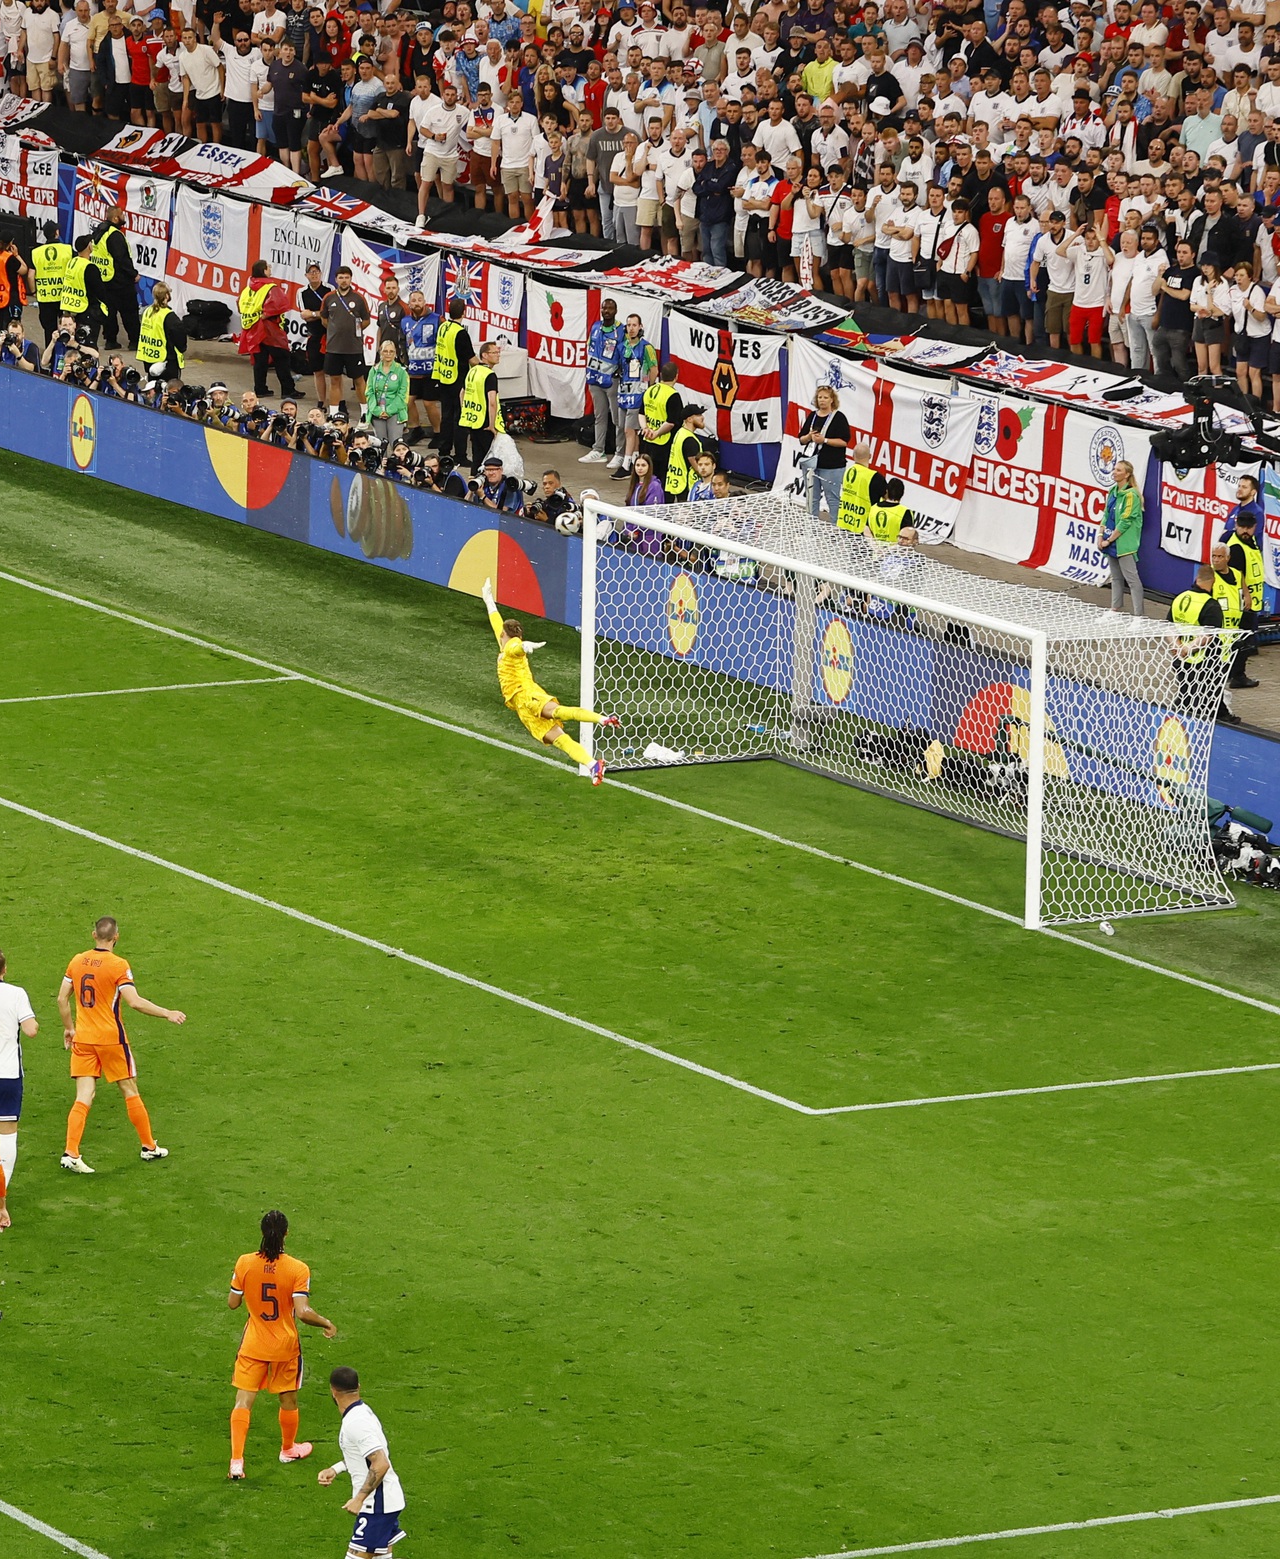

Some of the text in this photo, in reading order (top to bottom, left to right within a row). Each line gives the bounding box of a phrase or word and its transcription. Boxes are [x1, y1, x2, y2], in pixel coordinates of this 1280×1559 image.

[197, 144, 246, 168] ESSEX
[11, 183, 32, 201] ARE
[34, 188, 54, 205] QPR
[274, 228, 321, 253] ENGLAND
[136, 244, 157, 268] BB2
[271, 248, 292, 266] TILL
[1083, 273, 1091, 284] 8
[690, 327, 761, 359] WOLVES
[742, 412, 768, 432] WE
[929, 458, 960, 495] FC
[1166, 522, 1192, 544] DT7
[81, 974, 95, 1008] 6
[260, 1282, 279, 1321] 5
[355, 1517, 367, 1537] 2
